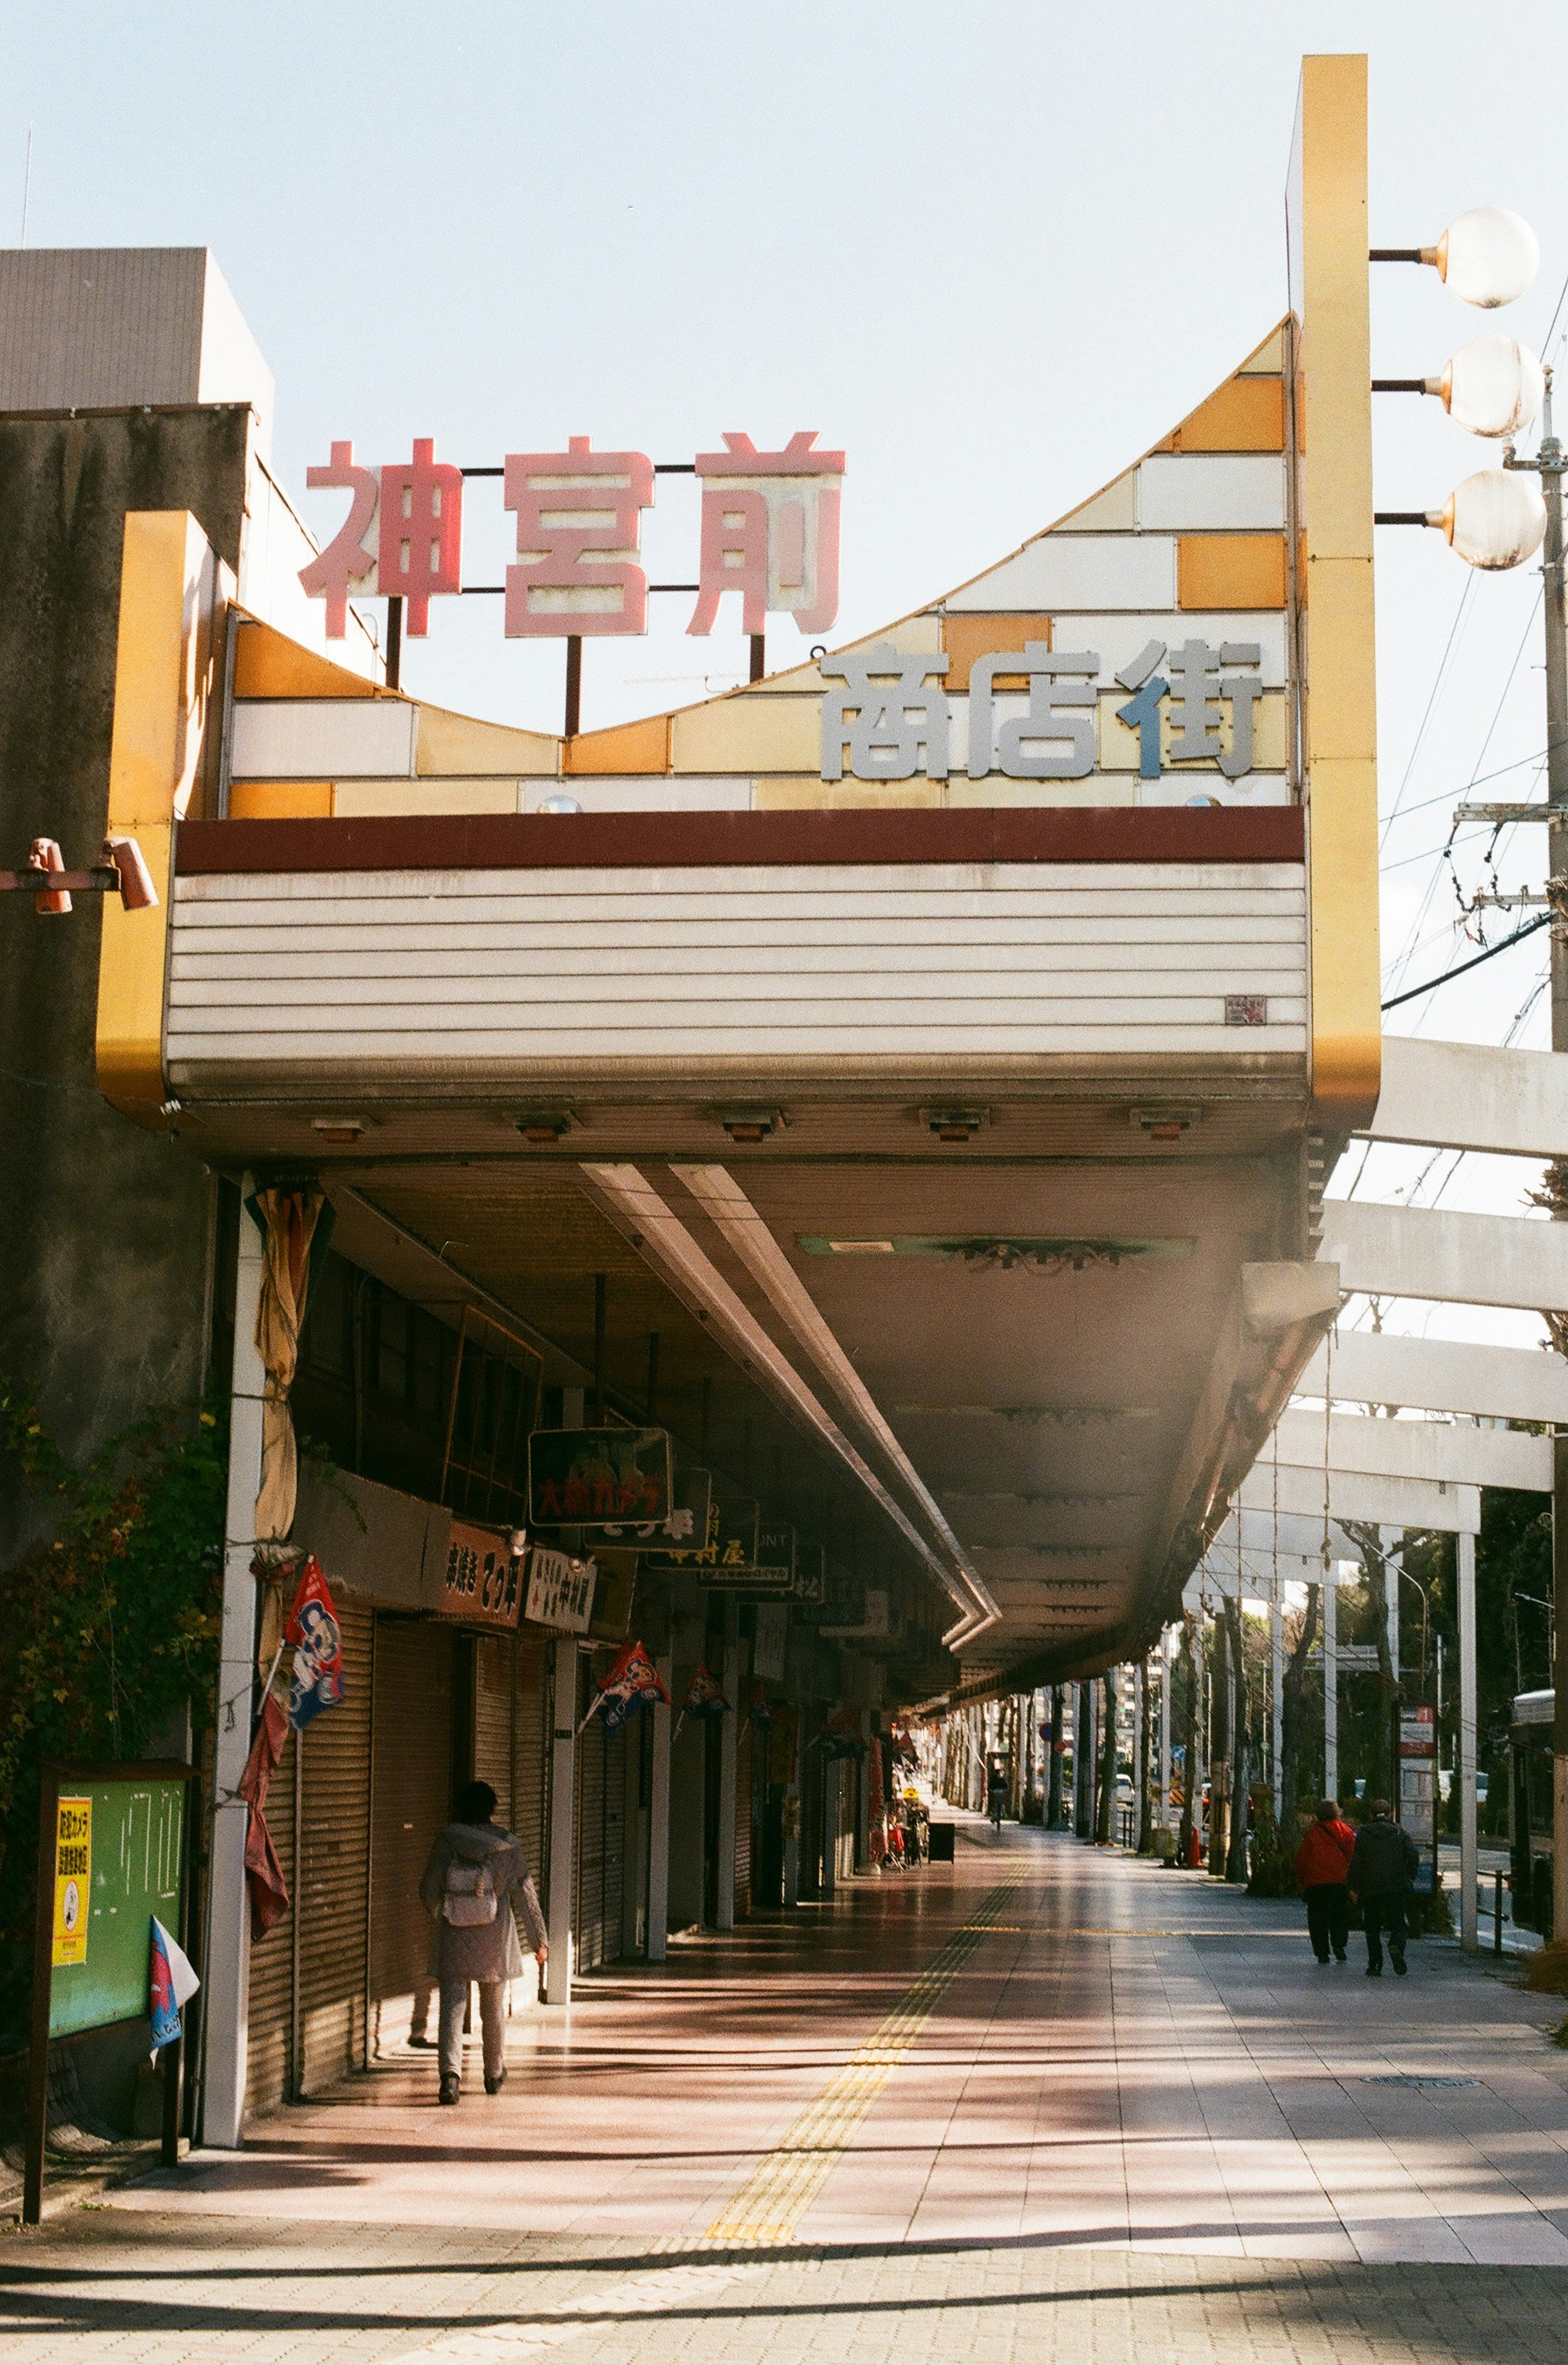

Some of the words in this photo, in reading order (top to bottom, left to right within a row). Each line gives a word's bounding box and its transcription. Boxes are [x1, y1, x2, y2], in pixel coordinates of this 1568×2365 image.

[298, 431, 846, 639] 神宮前
[819, 639, 1262, 780] 商店街
[60, 1810, 87, 1839] 防犯カメラ
